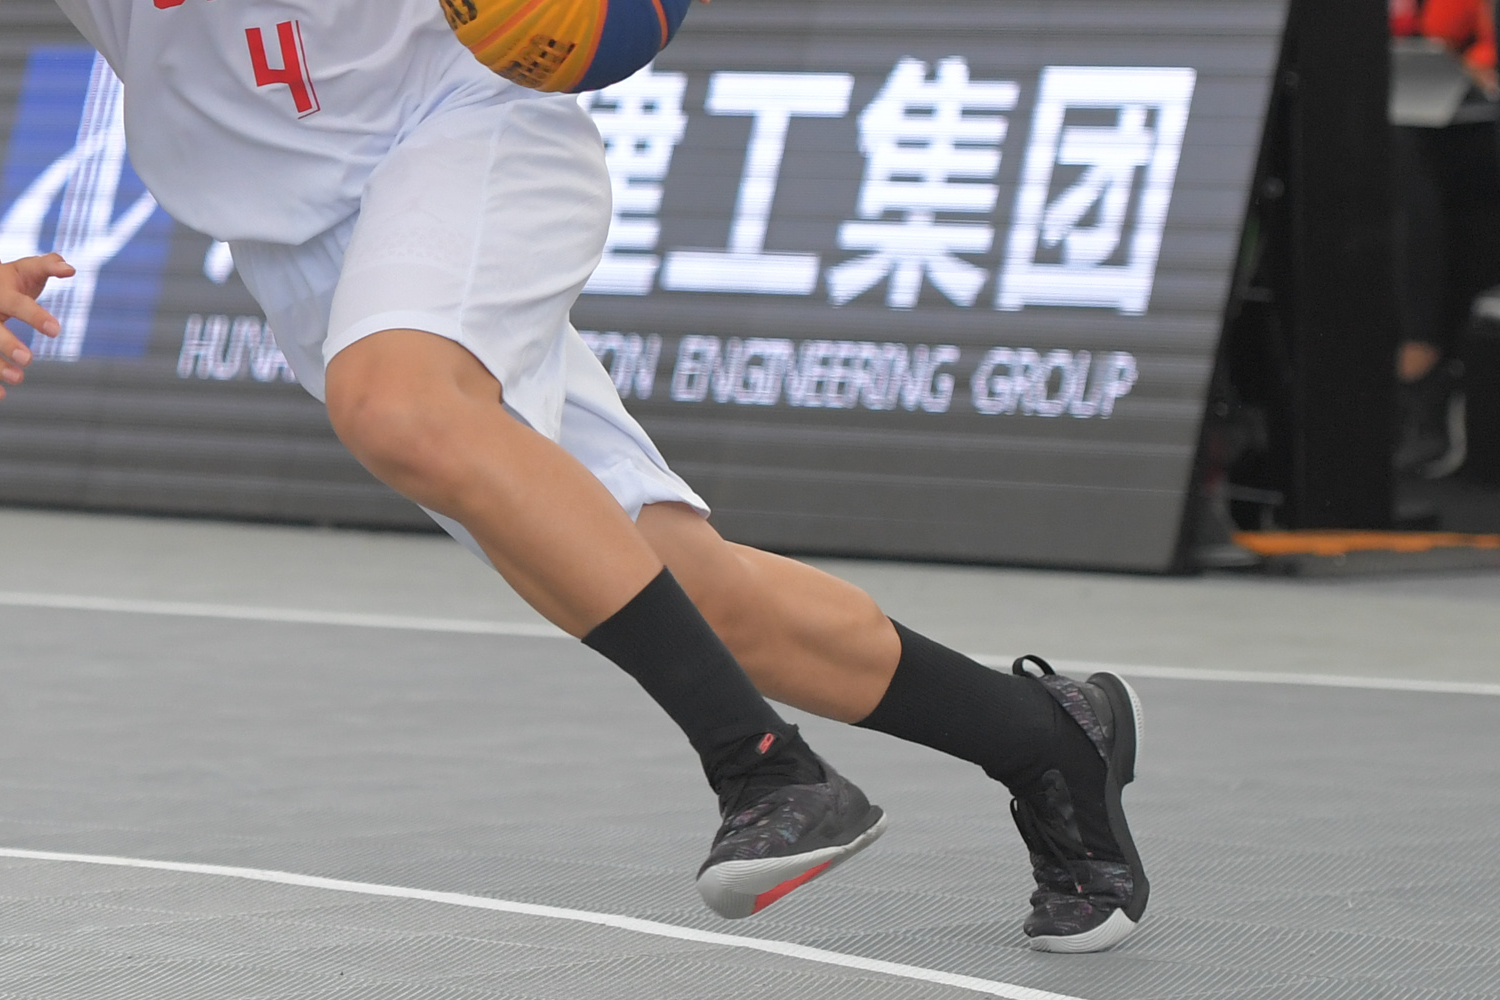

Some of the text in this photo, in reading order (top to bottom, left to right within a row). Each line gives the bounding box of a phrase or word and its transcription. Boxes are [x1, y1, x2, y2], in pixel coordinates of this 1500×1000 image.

[244, 19, 321, 120] 4
[670, 333, 960, 414] ENGINEERING
[969, 345, 1139, 419] GROUP
